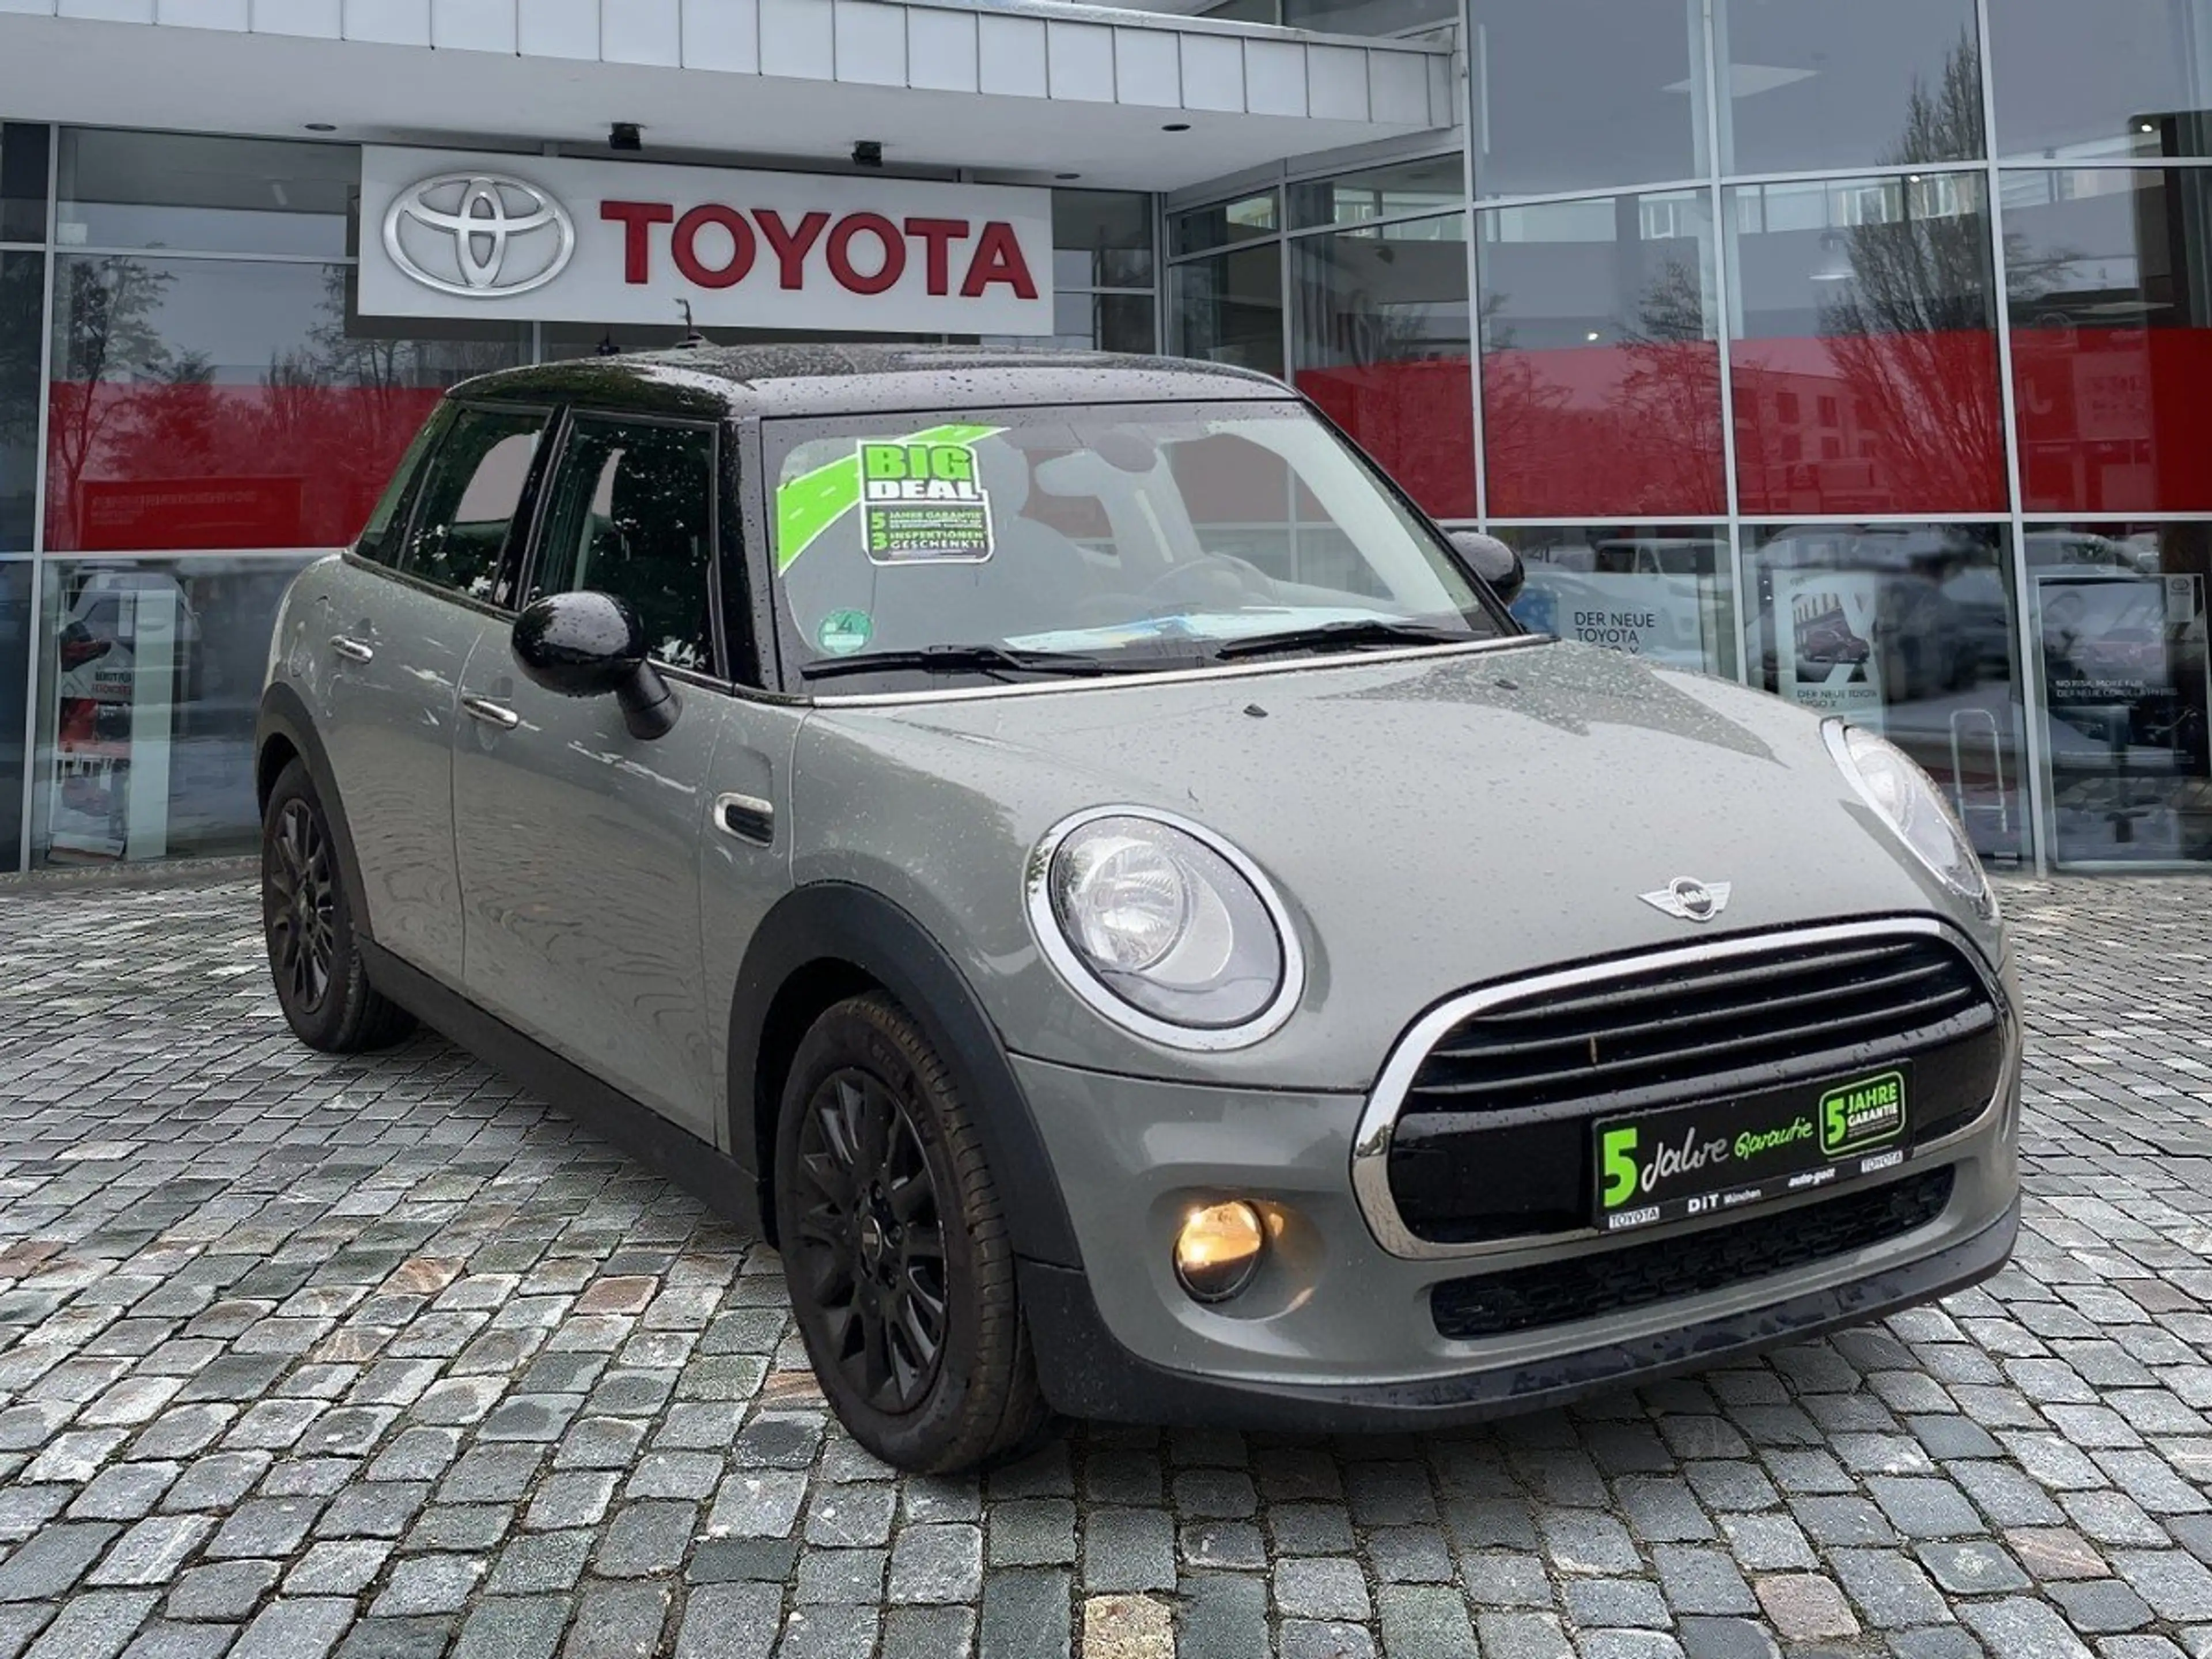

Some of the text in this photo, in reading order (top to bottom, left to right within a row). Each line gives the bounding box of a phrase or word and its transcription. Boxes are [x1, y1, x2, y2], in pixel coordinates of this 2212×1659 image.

[601, 200, 1039, 300] TOYOTA
[866, 445, 972, 479] BIG
[868, 480, 979, 499] DEAL
[872, 512, 885, 529] 5
[872, 532, 887, 550] 3
[838, 614, 852, 632] 4
[1574, 612, 1656, 628] DER NEUE
[1575, 628, 1639, 643] TOYOTA
[1827, 1097, 1846, 1145] 5
[1847, 1082, 1897, 1114] JAHRE
[1847, 1103, 1899, 1127] GARANTIE
[1604, 1117, 1813, 1207] 5 Jahre Garantie
[1611, 1209, 1658, 1228] TOYOTA
[1688, 1194, 1719, 1213] DIT
[1862, 1151, 1902, 1172] TOYOTA
